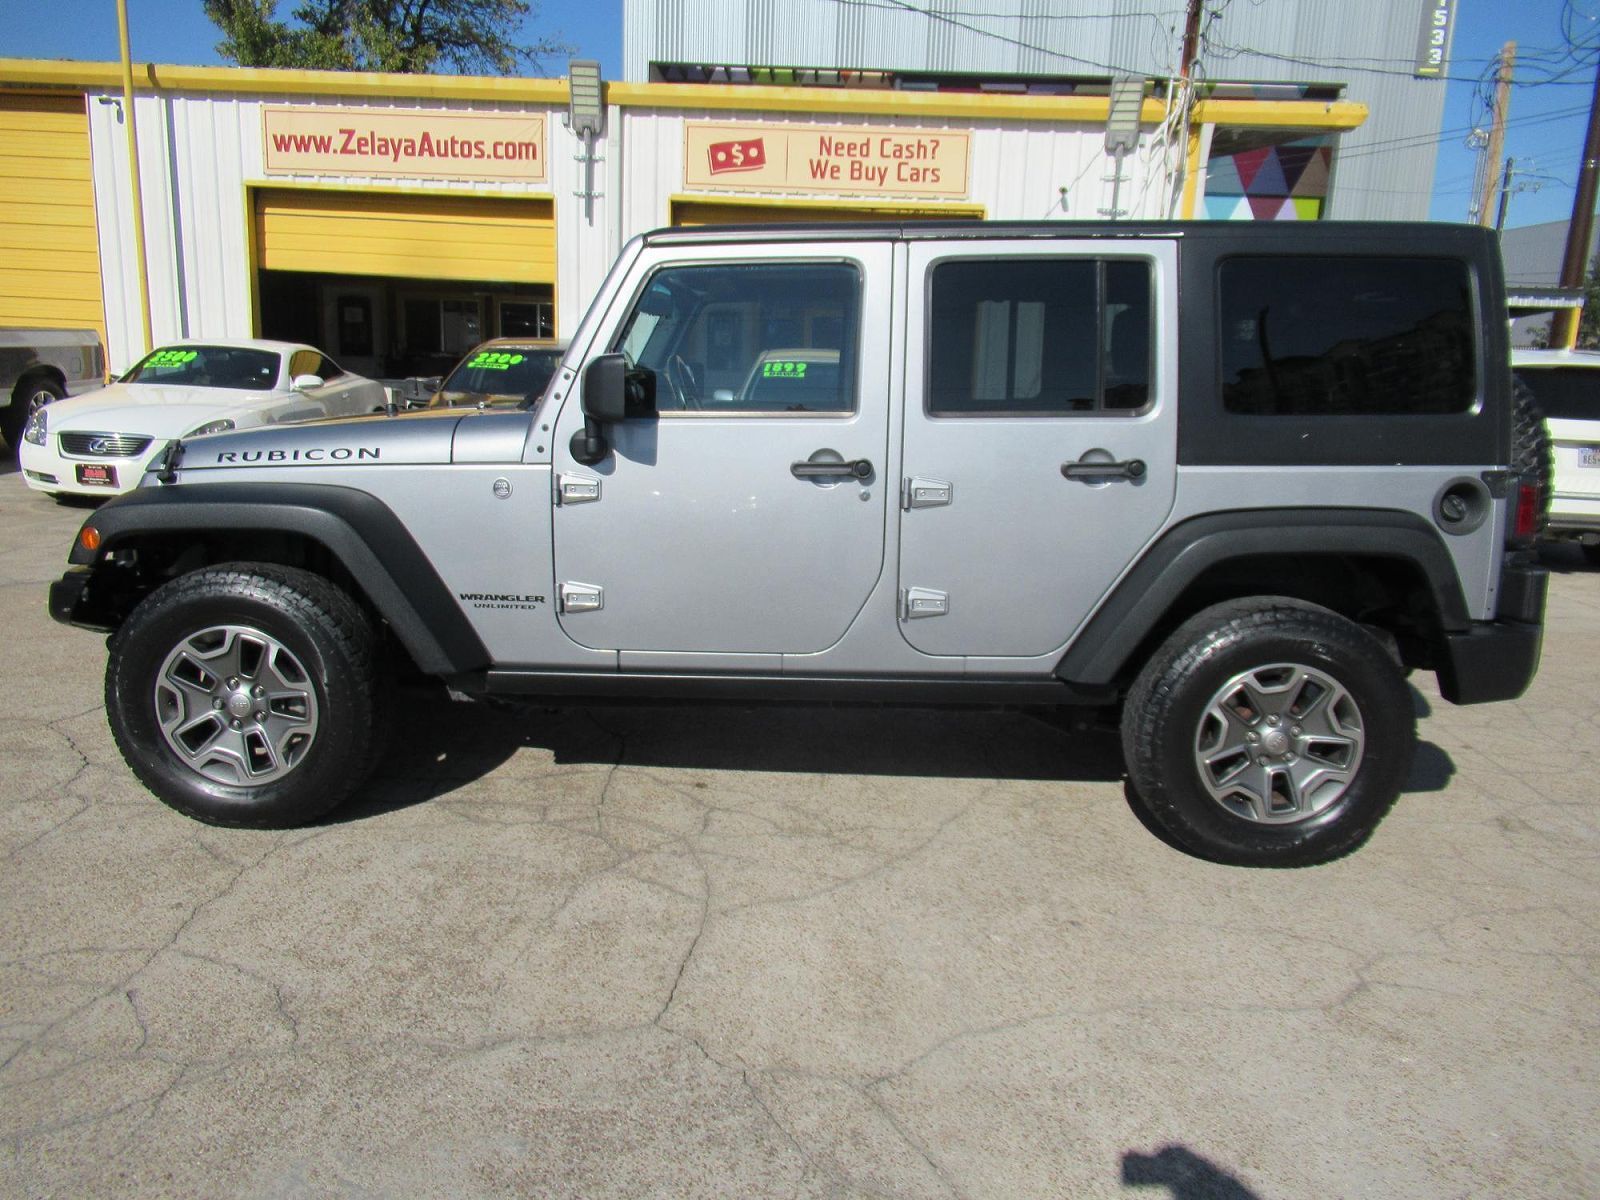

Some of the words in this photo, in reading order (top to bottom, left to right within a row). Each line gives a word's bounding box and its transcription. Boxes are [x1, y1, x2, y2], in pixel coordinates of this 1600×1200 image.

[273, 128, 538, 162] www.ZelayaAutos.com
[818, 135, 870, 157] Need
[879, 137, 940, 160] Cash?
[809, 158, 841, 180] We
[849, 160, 888, 186] Buy
[897, 161, 941, 183] Cars
[474, 352, 523, 364] 2200
[217, 448, 380, 462] RUBICON
[460, 594, 545, 603] WRANGLER
